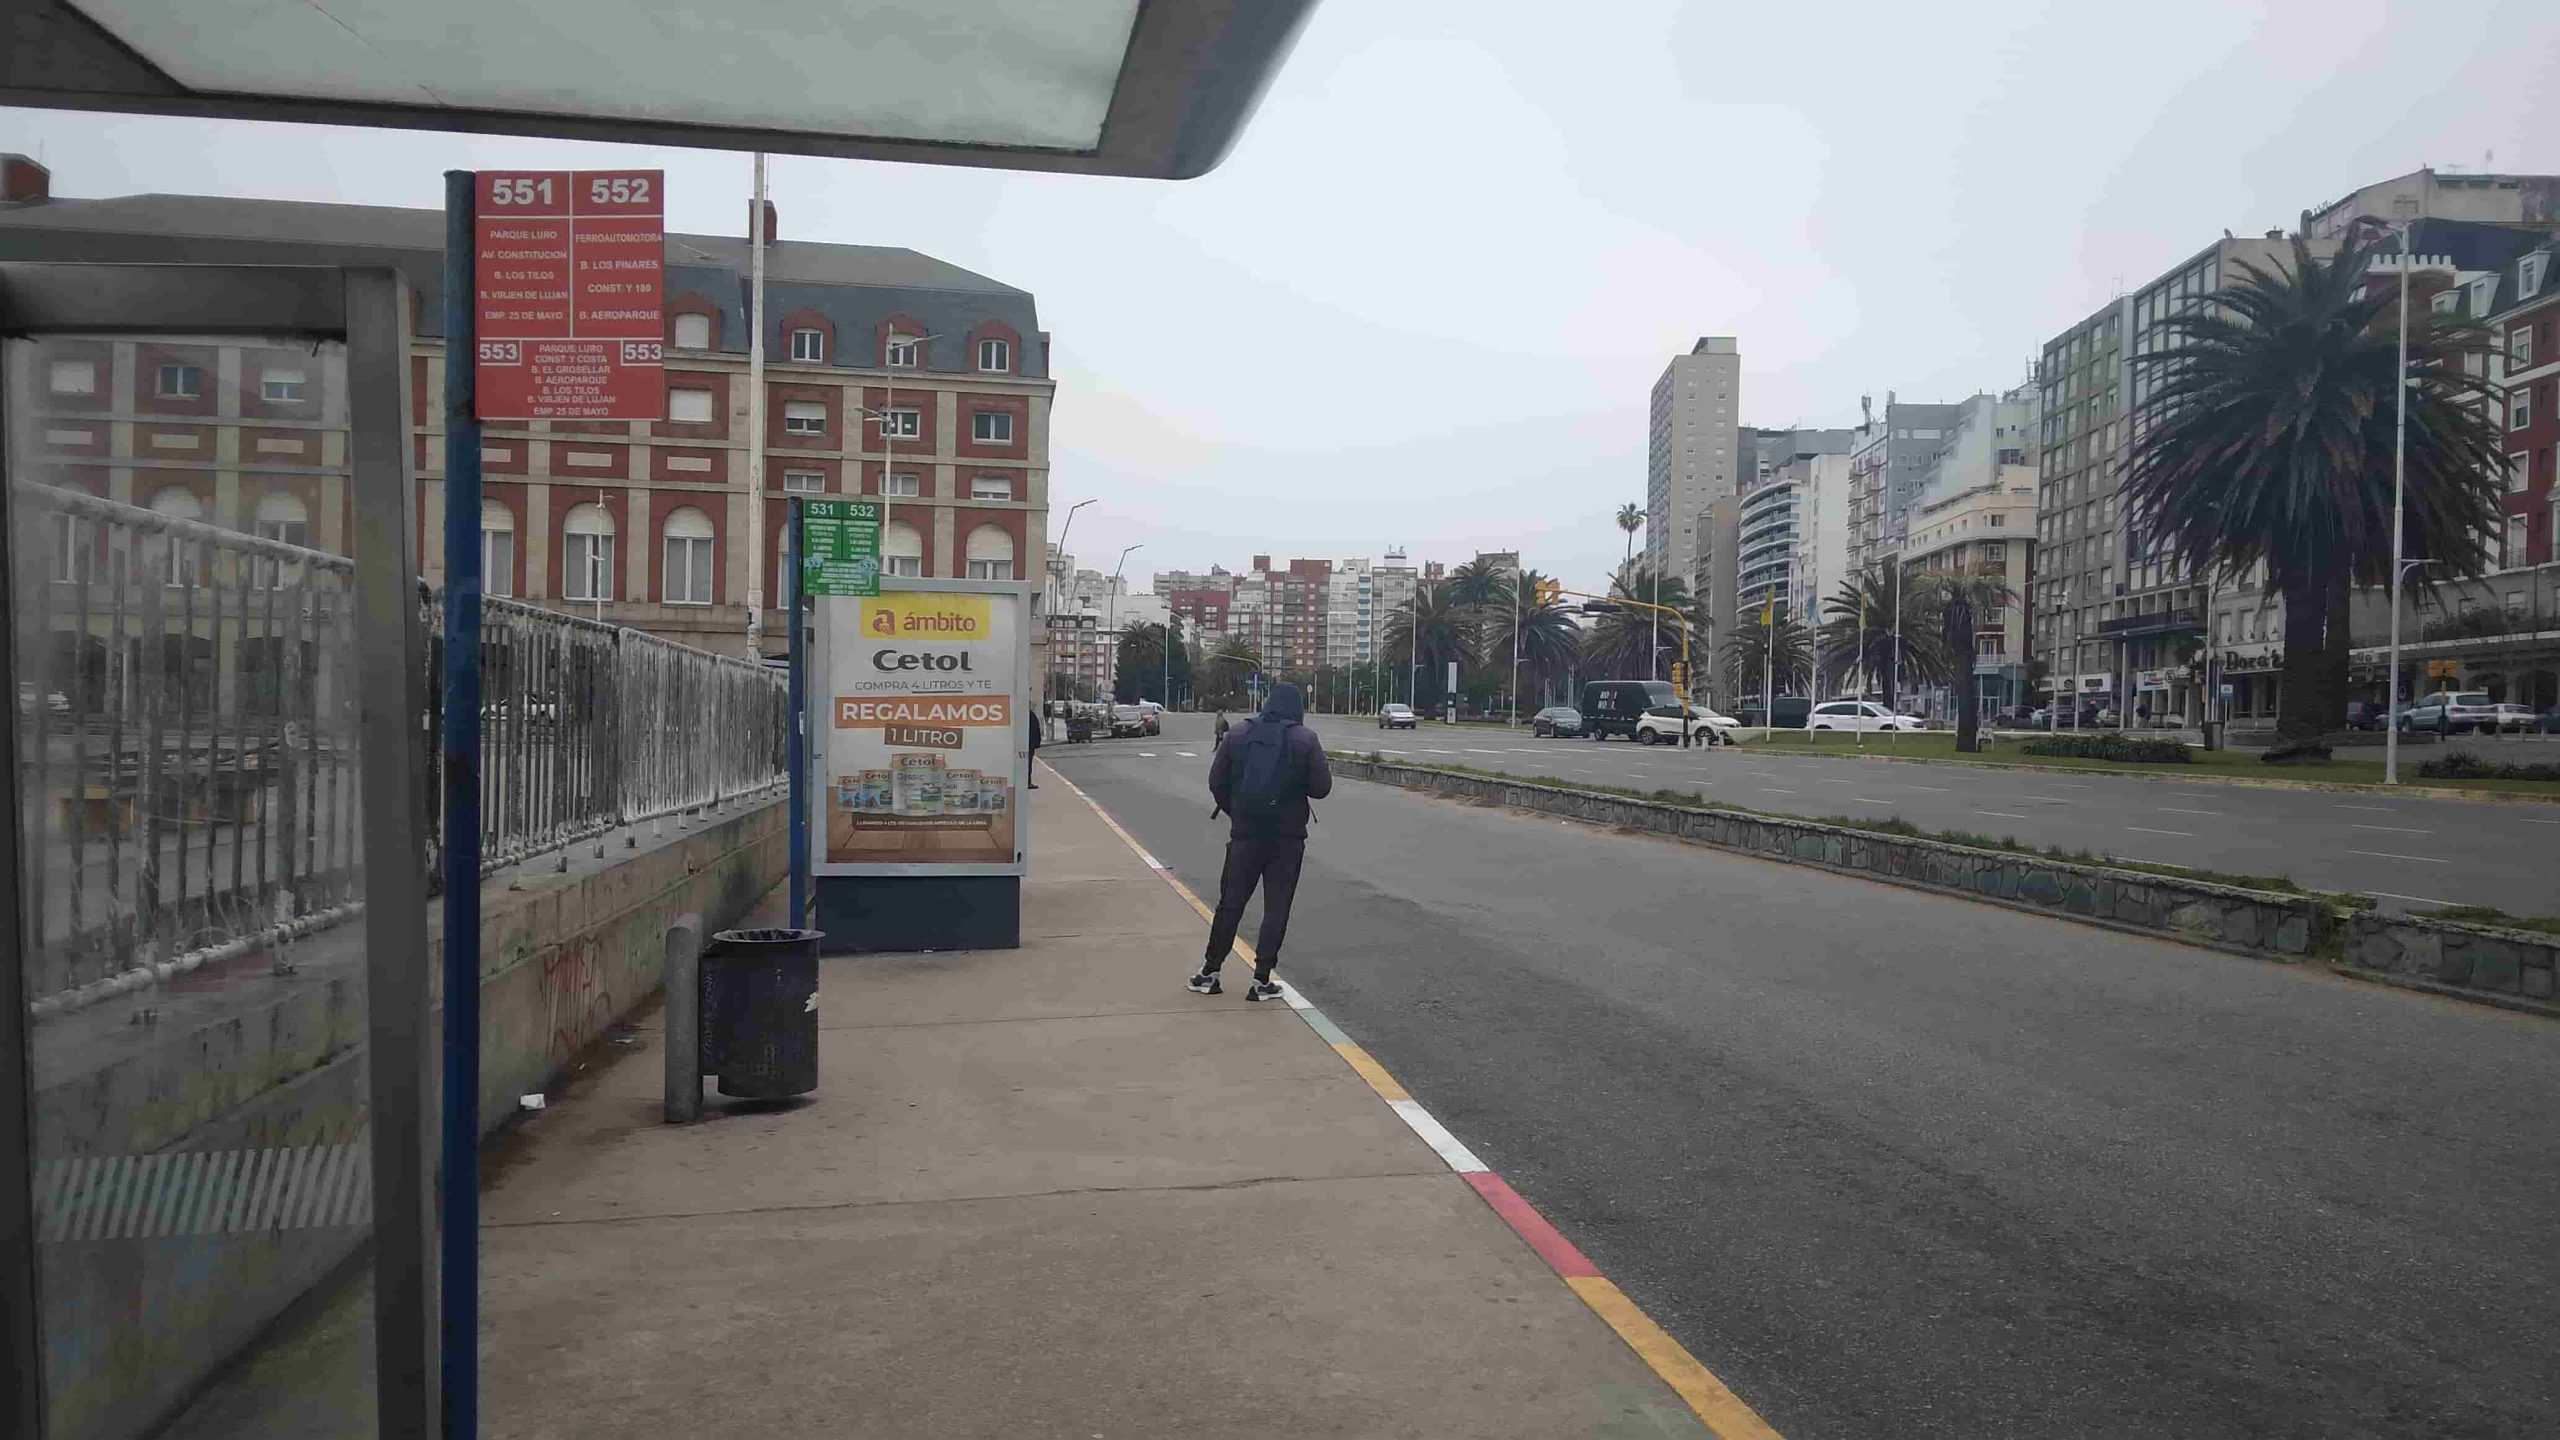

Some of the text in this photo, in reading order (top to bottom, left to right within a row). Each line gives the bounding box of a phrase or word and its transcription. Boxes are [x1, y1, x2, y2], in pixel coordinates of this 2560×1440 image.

[493, 179, 552, 204] 551
[591, 178, 649, 203] 552
[490, 231, 557, 240] PARQUE LURO
[575, 233, 662, 242] FERROAUTOMOTORA
[498, 251, 568, 259] CONSTITUCION
[593, 261, 614, 270] LOS
[616, 261, 658, 270] PINARES
[506, 271, 524, 280] LOS
[528, 271, 554, 280] TILOS
[626, 284, 633, 293] Y
[526, 291, 537, 300] DE
[509, 312, 520, 320] 25
[522, 312, 534, 320] DE
[536, 312, 563, 320] MAYO
[591, 311, 660, 320] AEROPARQUE
[480, 344, 518, 360] 553
[539, 344, 603, 353] PARQUE LURO
[624, 344, 662, 360] 553
[569, 355, 575, 364] Y
[577, 355, 608, 364] COSTA
[543, 366, 554, 374] EL
[556, 366, 611, 374] GROSELLAR
[545, 376, 608, 384] AEROPARQUE
[554, 387, 572, 395] LOS
[574, 387, 600, 395] TILOS
[574, 395, 585, 404] DE
[556, 408, 566, 416] 25
[569, 408, 581, 416] DE
[582, 408, 609, 416] MAYO
[811, 504, 834, 515] 531
[850, 505, 874, 517] 532
[903, 612, 976, 632] ámbito
[873, 650, 972, 671] Cetol
[855, 680, 991, 690] COMPRA 4 LITROS Y TE
[842, 703, 1003, 721] REGALAMOS
[890, 728, 958, 745] 1 LITRO
[901, 756, 936, 766] Cetol
